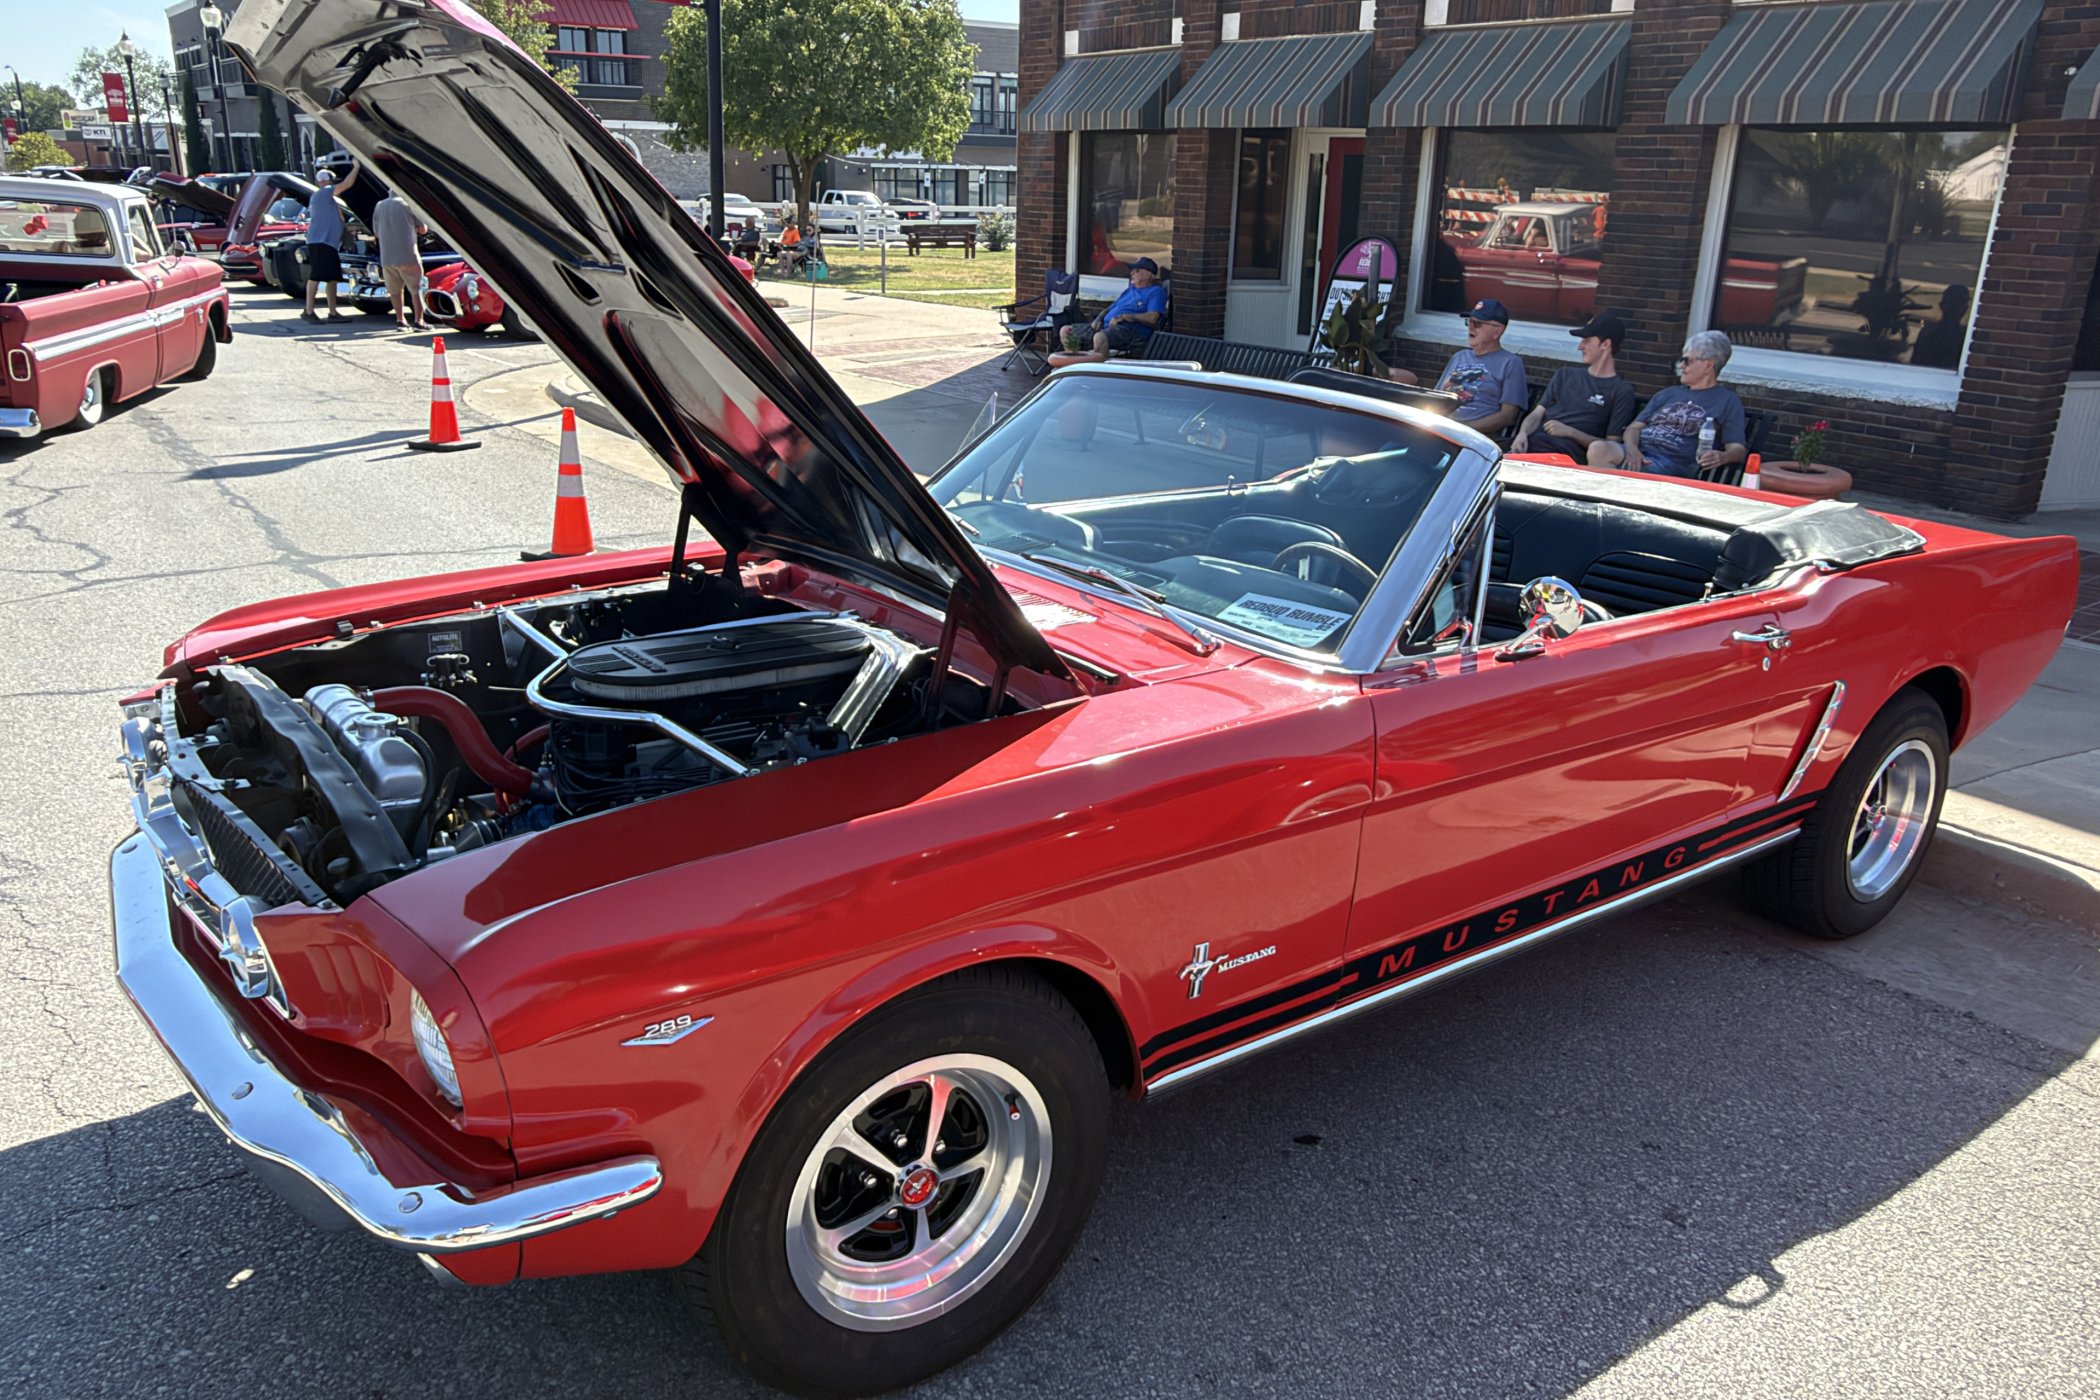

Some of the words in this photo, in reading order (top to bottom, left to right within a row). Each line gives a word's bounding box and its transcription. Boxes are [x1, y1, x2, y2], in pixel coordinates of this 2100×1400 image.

[1238, 600, 1291, 615] REDBUD
[1285, 608, 1344, 626] RUMBLE
[1377, 846, 1687, 978] MUSTANG
[1218, 945, 1277, 973] MUSTANG
[644, 1014, 692, 1038] 289
